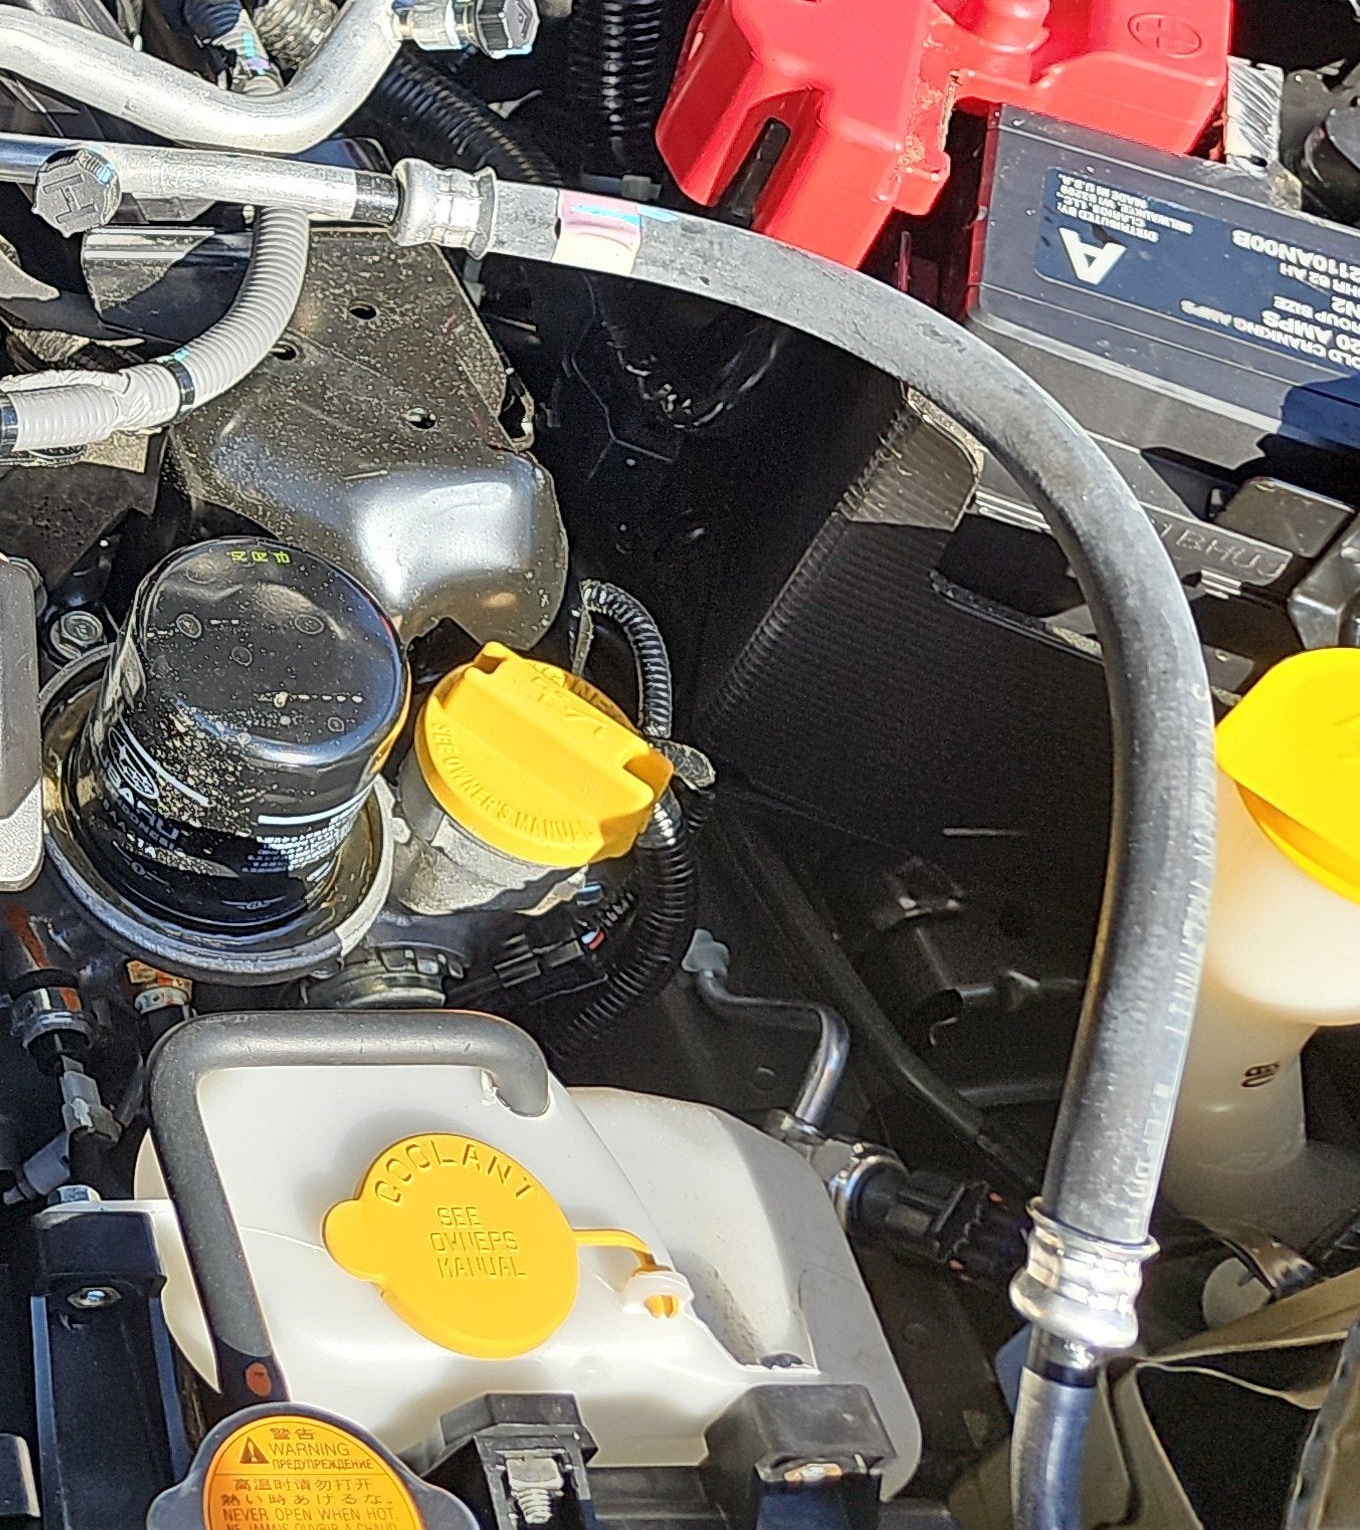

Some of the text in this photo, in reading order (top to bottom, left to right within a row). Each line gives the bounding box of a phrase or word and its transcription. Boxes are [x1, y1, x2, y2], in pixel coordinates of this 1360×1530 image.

[1273, 295, 1314, 319] SIZE
[1233, 316, 1328, 358] CRANKING
[1261, 309, 1334, 346] AMPS
[374, 1140, 533, 1204] COOLANT
[437, 1206, 482, 1227] SEE
[430, 1231, 519, 1252] OWNERS
[437, 1256, 527, 1279] MANUAL
[270, 1427, 316, 1440] 警告
[268, 1443, 350, 1457] WARNING
[222, 1508, 269, 1521] NEVER
[274, 1508, 313, 1521] OPEN
[317, 1508, 361, 1521] WHEN
